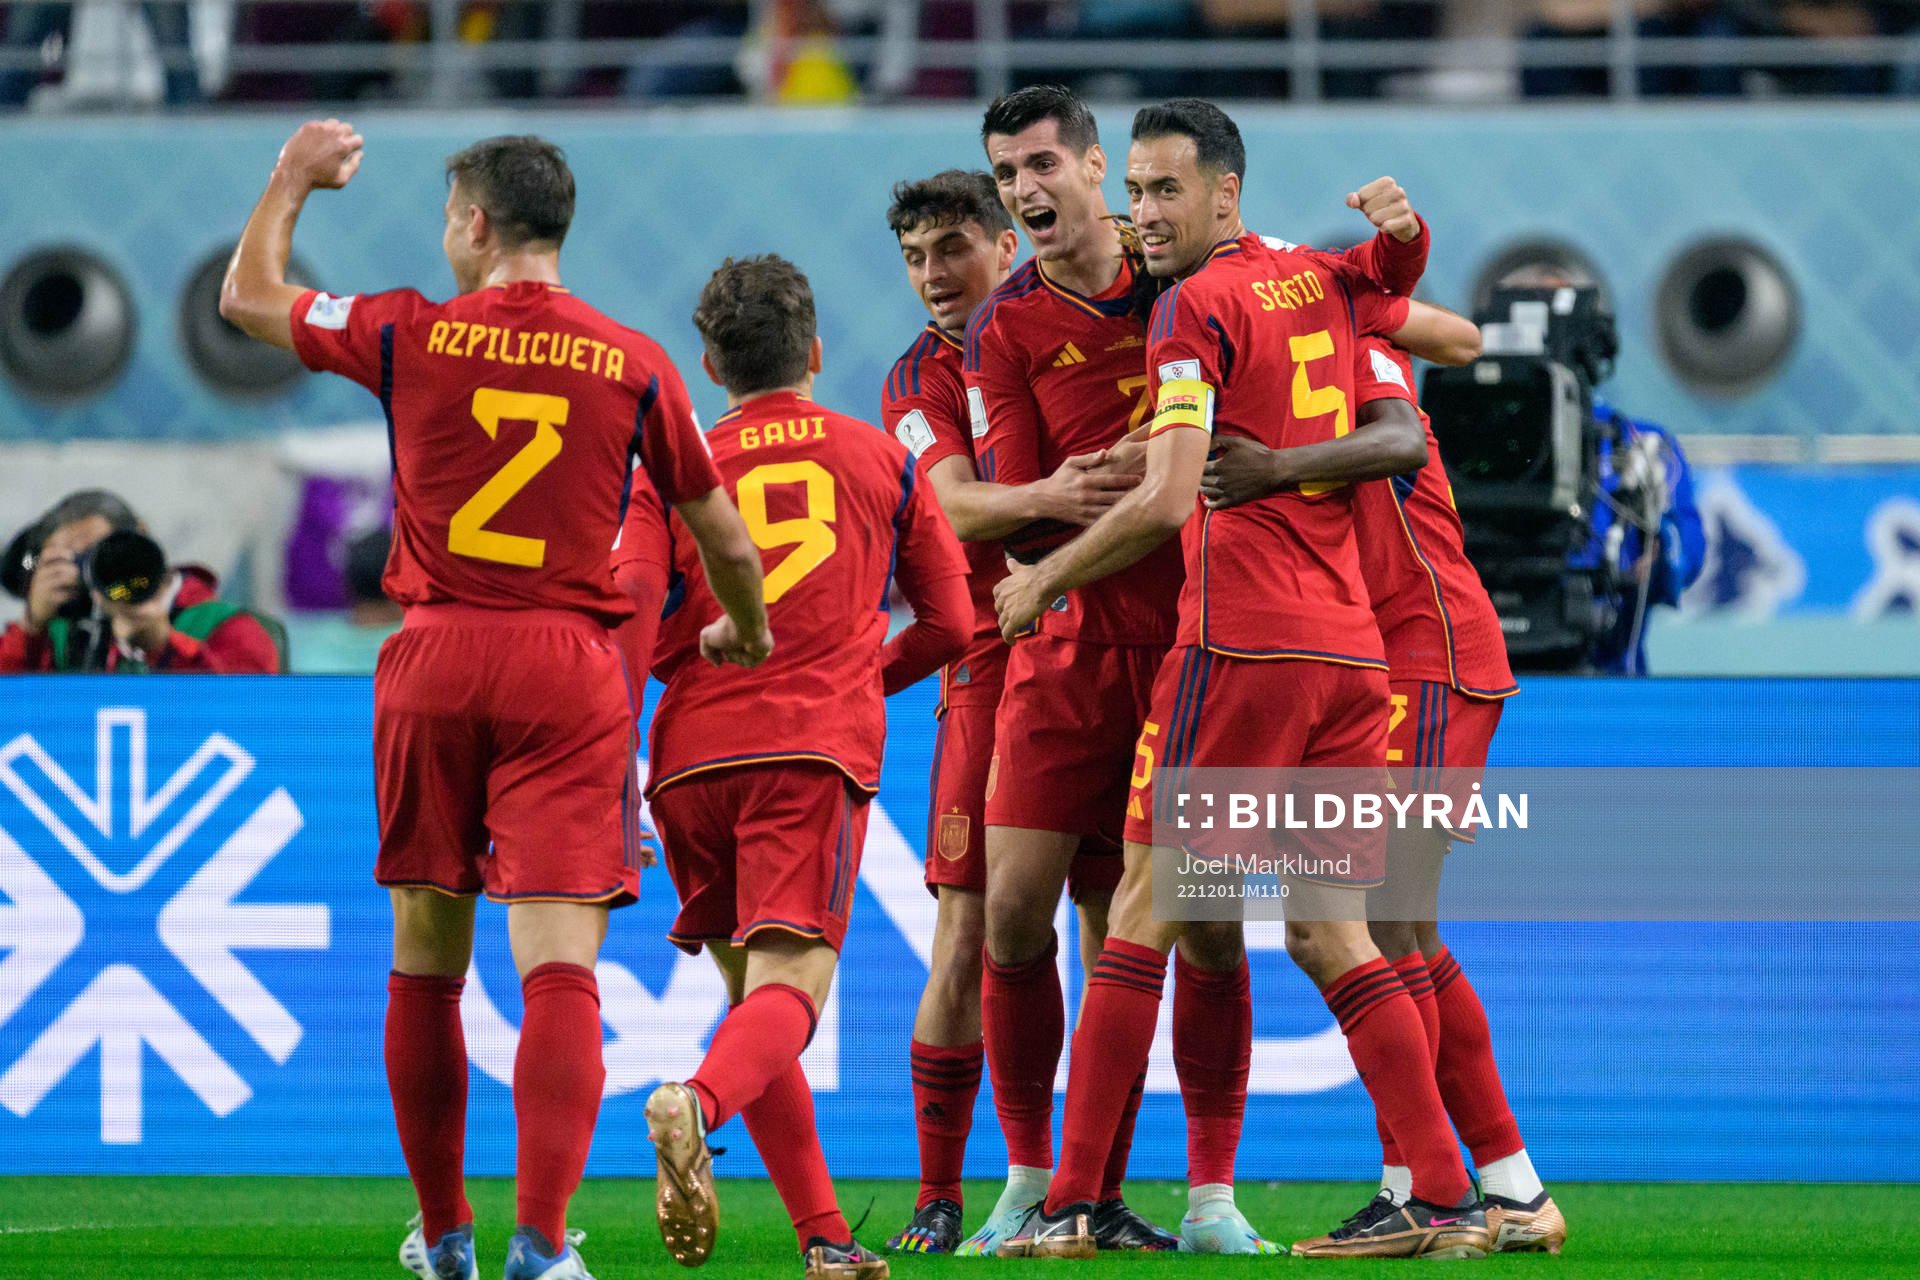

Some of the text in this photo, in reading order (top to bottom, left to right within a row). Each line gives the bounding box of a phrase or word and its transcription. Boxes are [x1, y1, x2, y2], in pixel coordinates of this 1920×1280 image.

[427, 320, 625, 382] AZPILICUETA
[739, 416, 827, 450] GAVI
[1289, 330, 1350, 496] 5
[447, 387, 570, 568] 2
[736, 459, 837, 604] 9
[1131, 720, 1160, 789] 5
